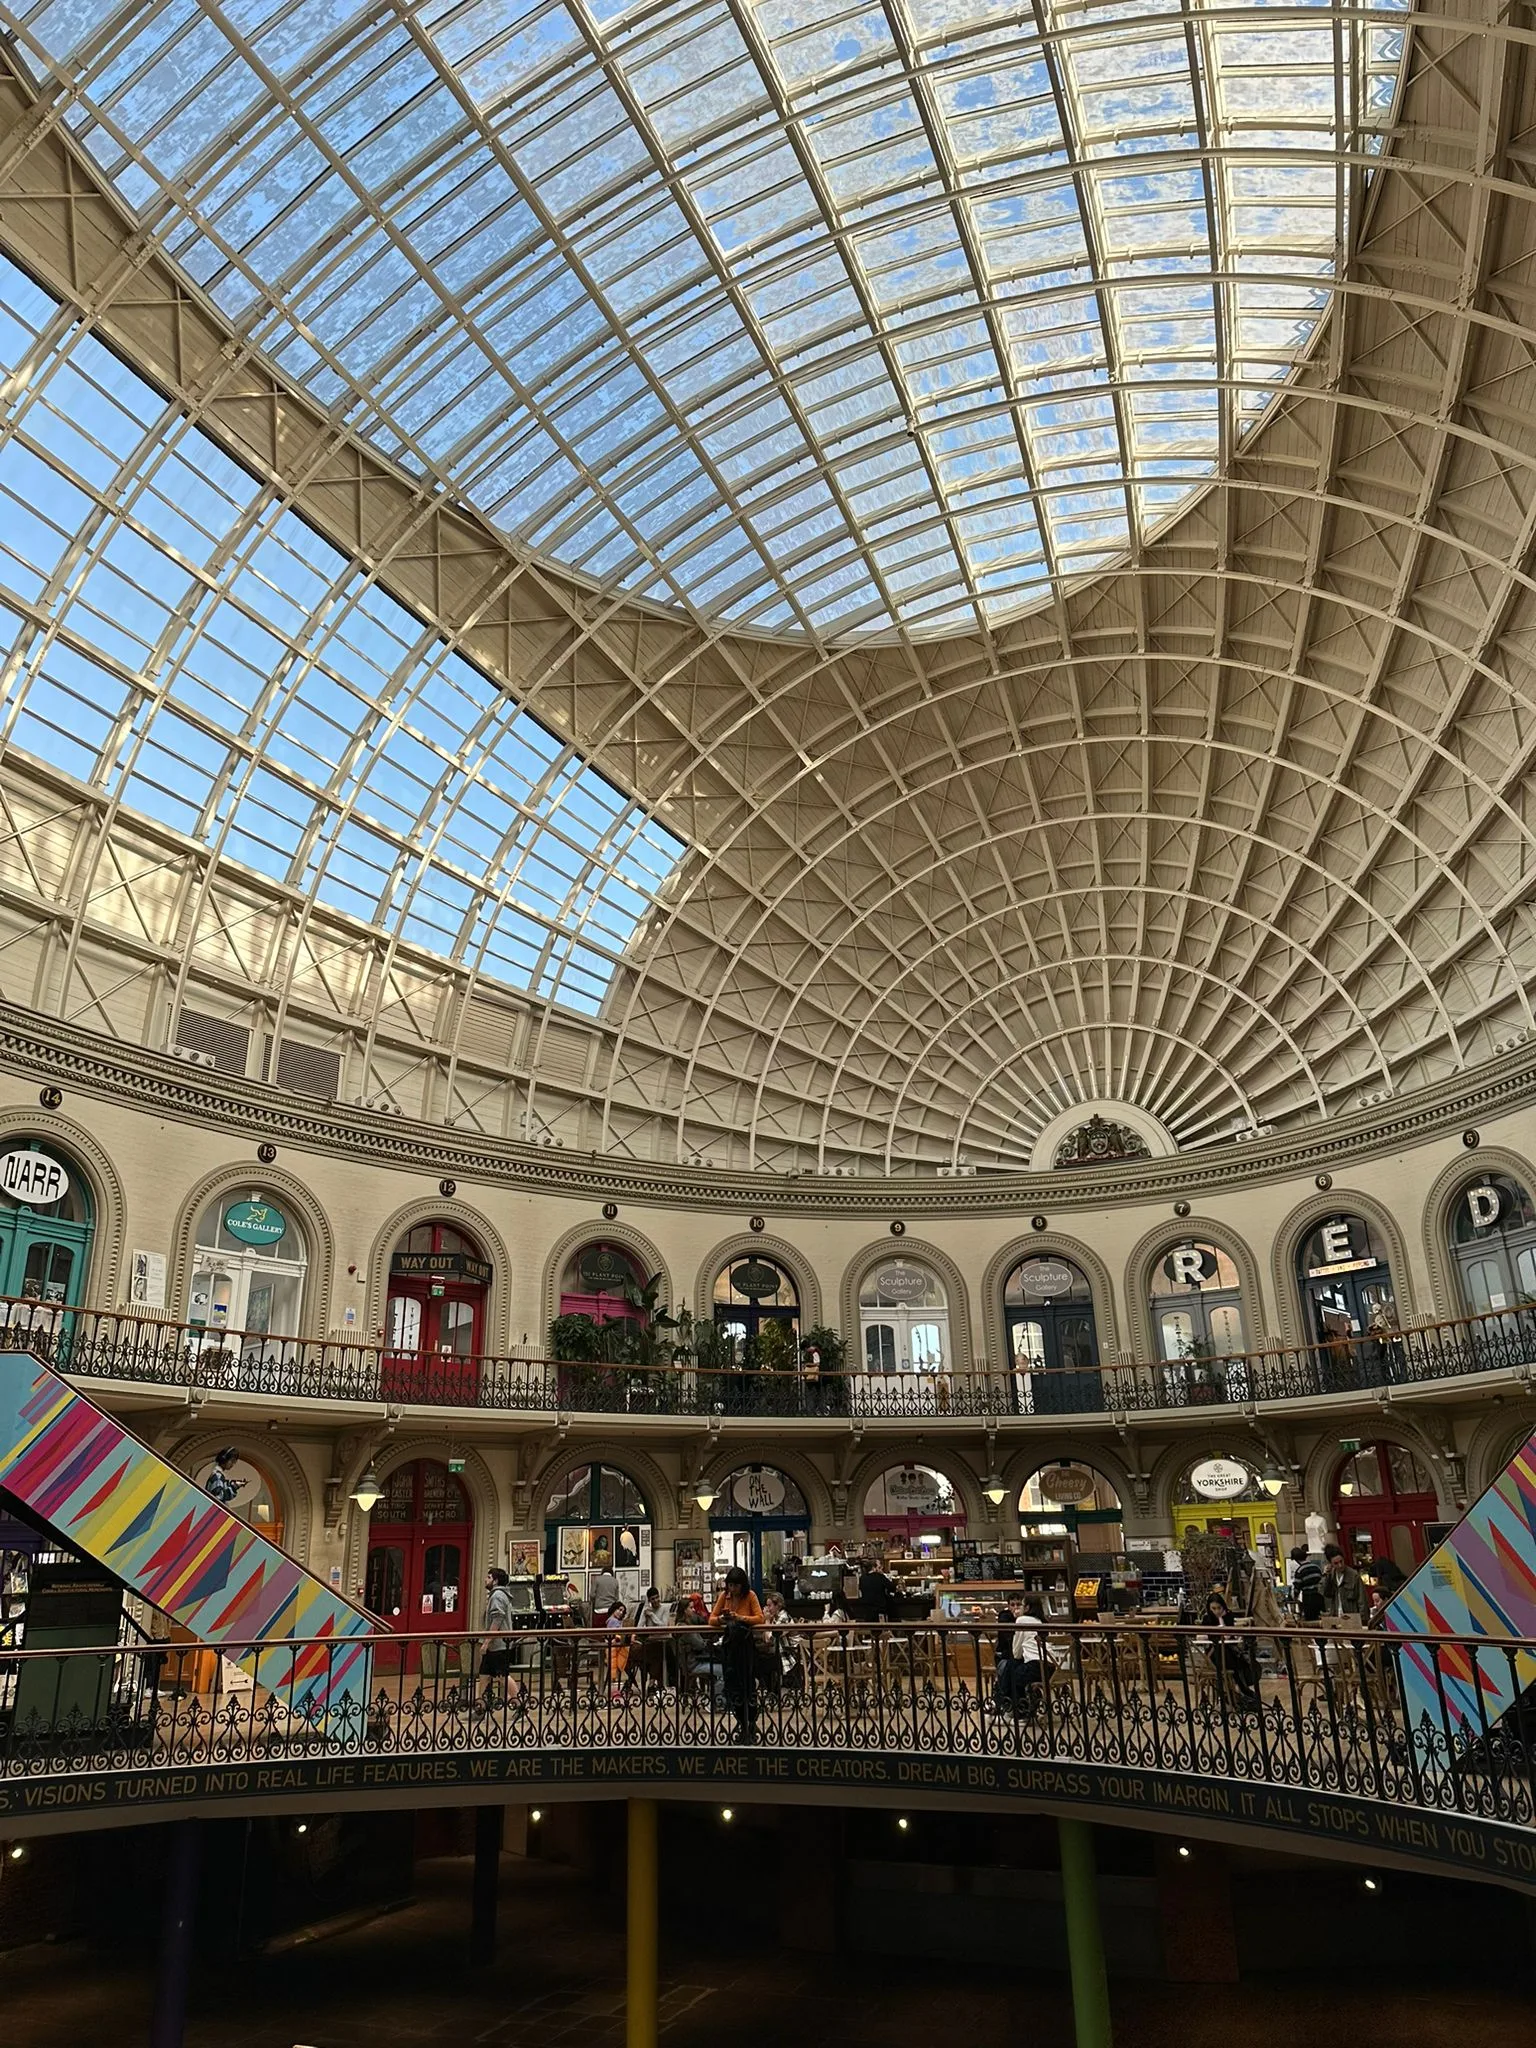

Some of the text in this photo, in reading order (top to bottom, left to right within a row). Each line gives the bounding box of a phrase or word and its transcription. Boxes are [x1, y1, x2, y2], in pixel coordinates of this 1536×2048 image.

[45, 1089, 61, 1104] 14
[263, 1145, 275, 1158] 13
[4, 1155, 61, 1199] NARR
[1318, 1176, 1326, 1187] 6
[443, 1181, 454, 1192] 12
[606, 1205, 615, 1215] 11
[1178, 1203, 1186, 1213] 7
[1467, 1186, 1500, 1228] D
[227, 1219, 284, 1235] COLE'S GALLERY
[753, 1219, 763, 1228] 10
[894, 1223, 902, 1232] 9
[1035, 1218, 1043, 1227] 8
[1322, 1222, 1353, 1262] E
[401, 1256, 454, 1269] WAY OUT
[465, 1258, 490, 1277] WAY OUT
[1173, 1249, 1208, 1284] R
[880, 1277, 923, 1288] Sculpture
[1022, 1271, 1068, 1283] Sculpture
[891, 1287, 913, 1296] Gallery
[1035, 1283, 1057, 1292] Gallery
[749, 1475, 761, 1485] ON
[1045, 1472, 1088, 1491] Cheesy
[1196, 1478, 1244, 1487] YORKSHIRE
[749, 1484, 768, 1496] THE
[748, 1493, 774, 1509] WALL
[377, 1510, 406, 1519] SOUTH
[24, 1781, 106, 1807] VISIONS
[115, 1775, 197, 1800] TURNED
[205, 1771, 249, 1793] INTO
[257, 1768, 308, 1789] REAL
[316, 1766, 356, 1786] LIFE
[363, 1761, 461, 1782] FEATURES.
[470, 1759, 499, 1778] WE
[505, 1758, 542, 1777] ARE
[550, 1757, 584, 1775] THE
[591, 1756, 670, 1775] MAKERS.
[678, 1756, 706, 1775] WE
[712, 1756, 749, 1776] ARE
[755, 1757, 789, 1776] THE
[796, 1758, 891, 1780] CREATORS.
[898, 1761, 960, 1784] DREAM
[1007, 1768, 1091, 1796] SURPASS
[1097, 1775, 1146, 1801] YOUR
[1240, 1791, 1256, 1816] IT
[1265, 1795, 1301, 1823] ALL
[1307, 1802, 1369, 1835] STOPS
[1375, 1813, 1440, 1849] WHEN
[1444, 1825, 1486, 1860] YOU
